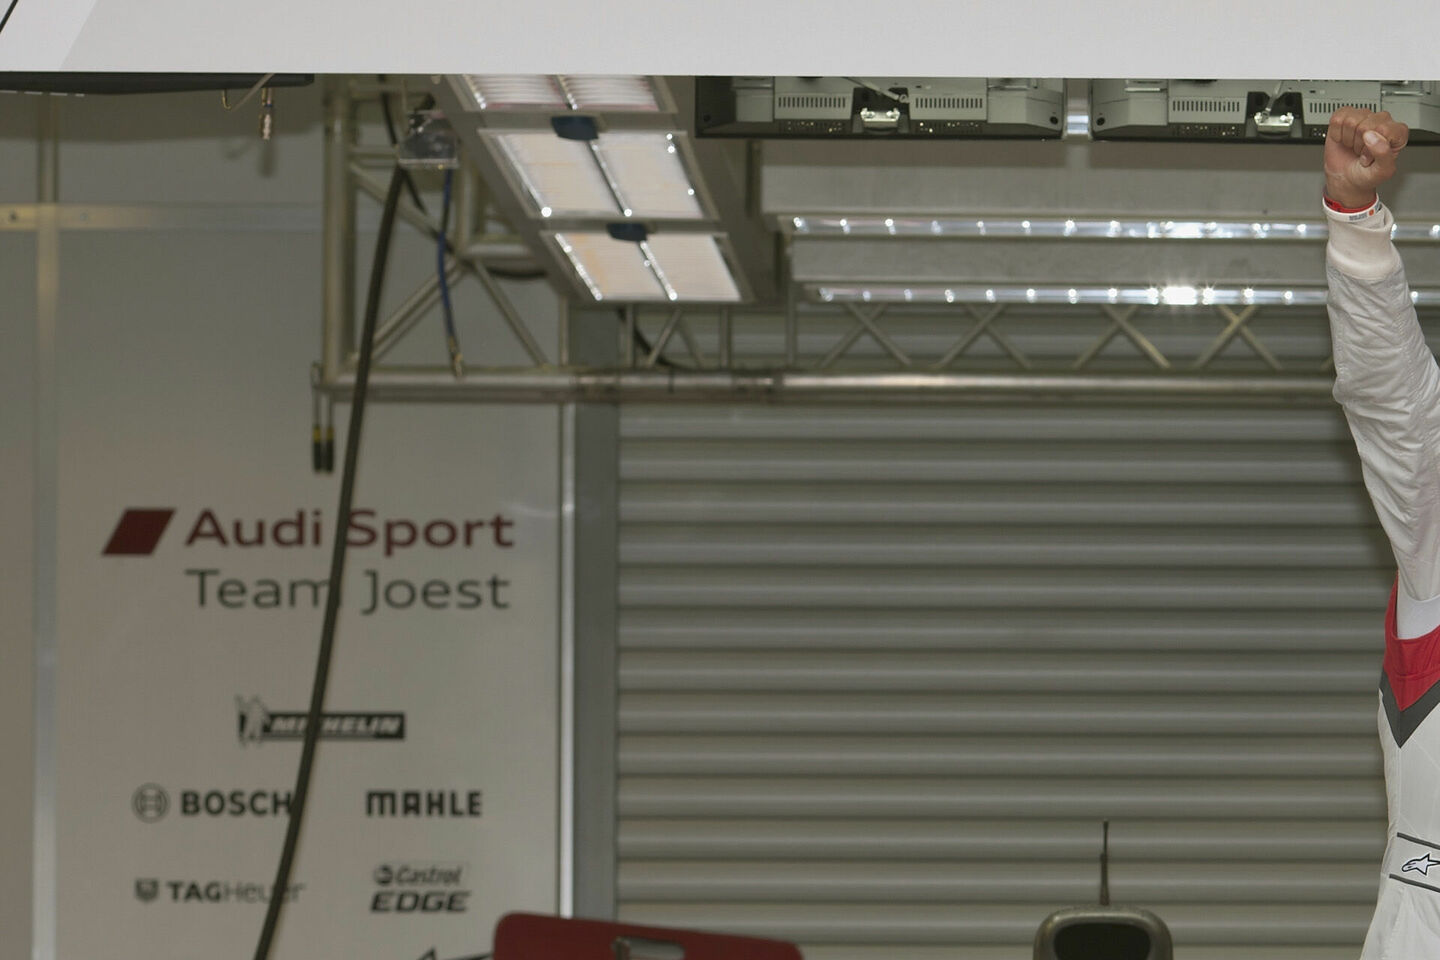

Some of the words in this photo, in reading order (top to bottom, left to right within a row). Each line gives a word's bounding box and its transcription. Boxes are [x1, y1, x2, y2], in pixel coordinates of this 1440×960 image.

[185, 509, 322, 548] Audi
[346, 509, 515, 557] Sport
[184, 569, 342, 609] Team
[361, 569, 511, 615] Joest
[270, 715, 401, 734] MIHELIN
[181, 792, 294, 817] BOSCH
[366, 791, 482, 817] MAHLE
[395, 866, 461, 886] Castrol
[167, 880, 305, 903] TAGHeur
[370, 891, 470, 914] EDGE
